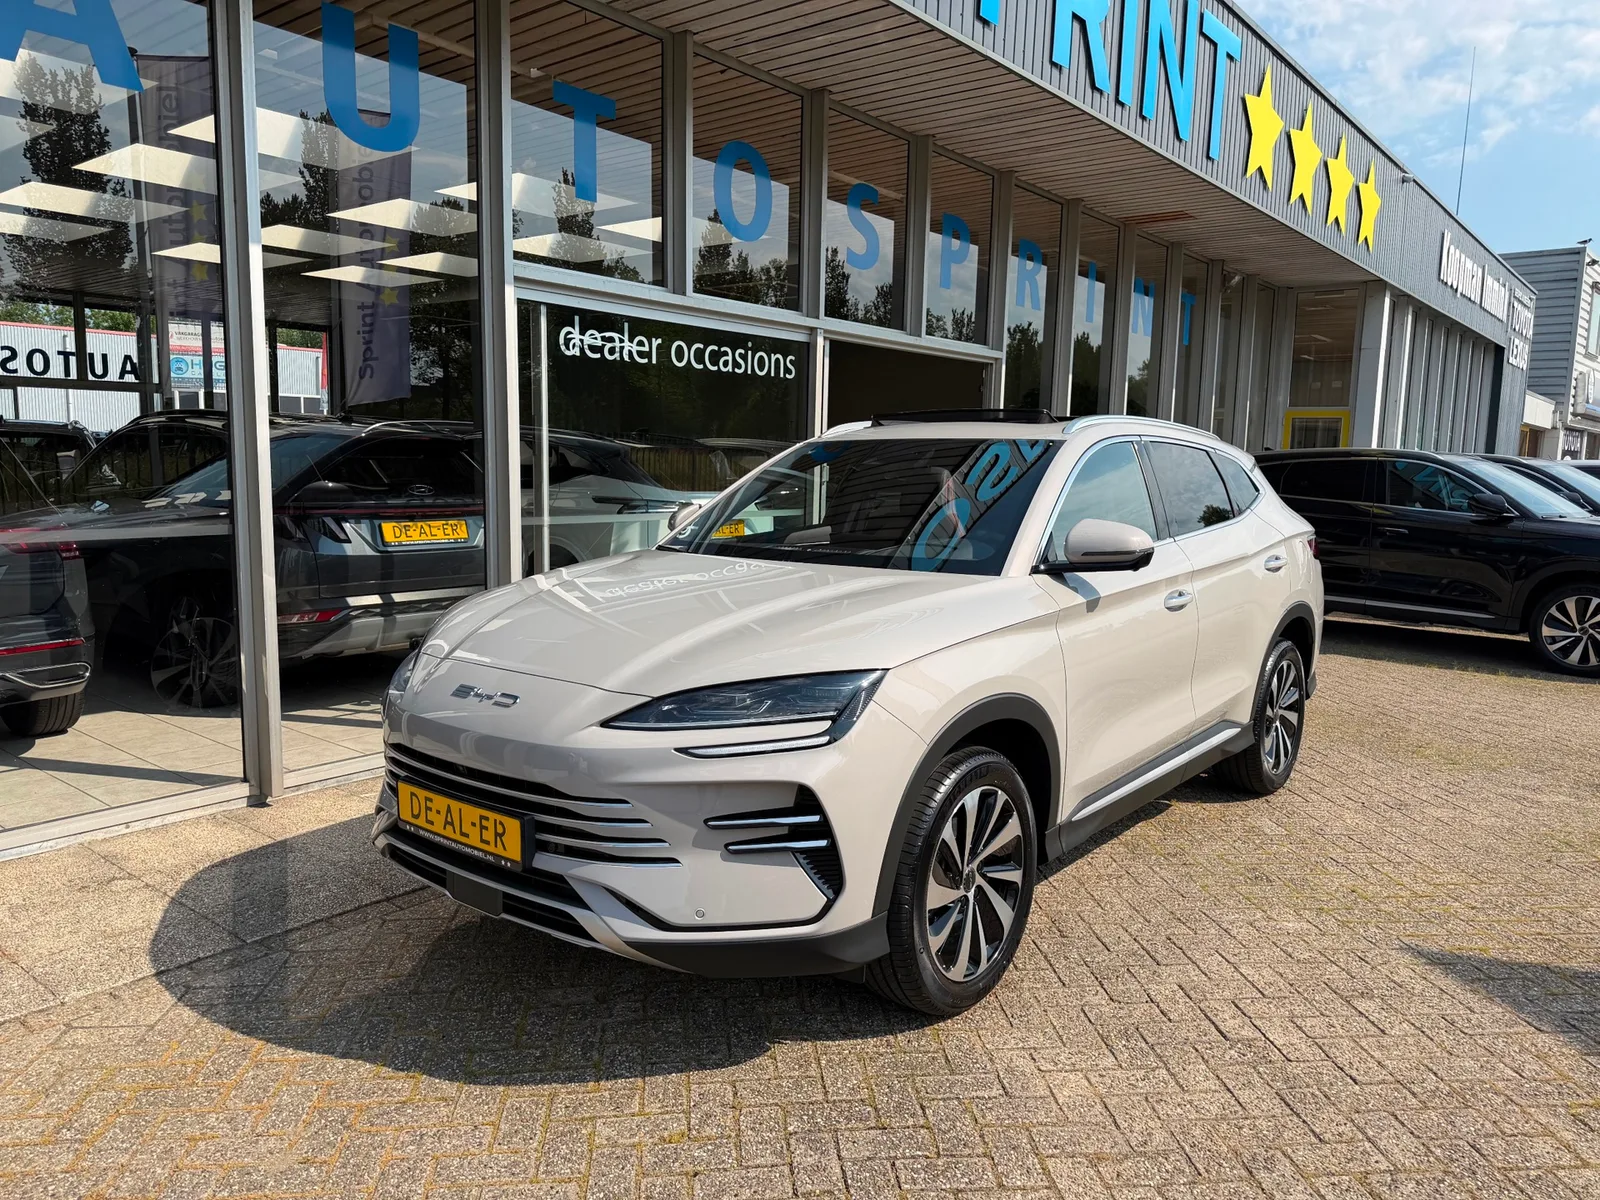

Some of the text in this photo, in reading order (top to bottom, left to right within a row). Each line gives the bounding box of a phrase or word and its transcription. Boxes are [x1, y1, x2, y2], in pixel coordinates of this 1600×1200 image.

[979, 0, 1242, 162] RINT
[1440, 228, 1482, 304] Koopman
[356, 301, 378, 380] Sprint
[559, 315, 796, 379] dealer occasions
[1511, 300, 1534, 340] TOYOTA
[1508, 335, 1529, 371] LEXUS
[392, 522, 461, 539] DE-AL-ER
[410, 790, 507, 851] DE-AL-ER
[418, 828, 496, 862] WWW.SPRINTAUTOMOBIEL.NL
